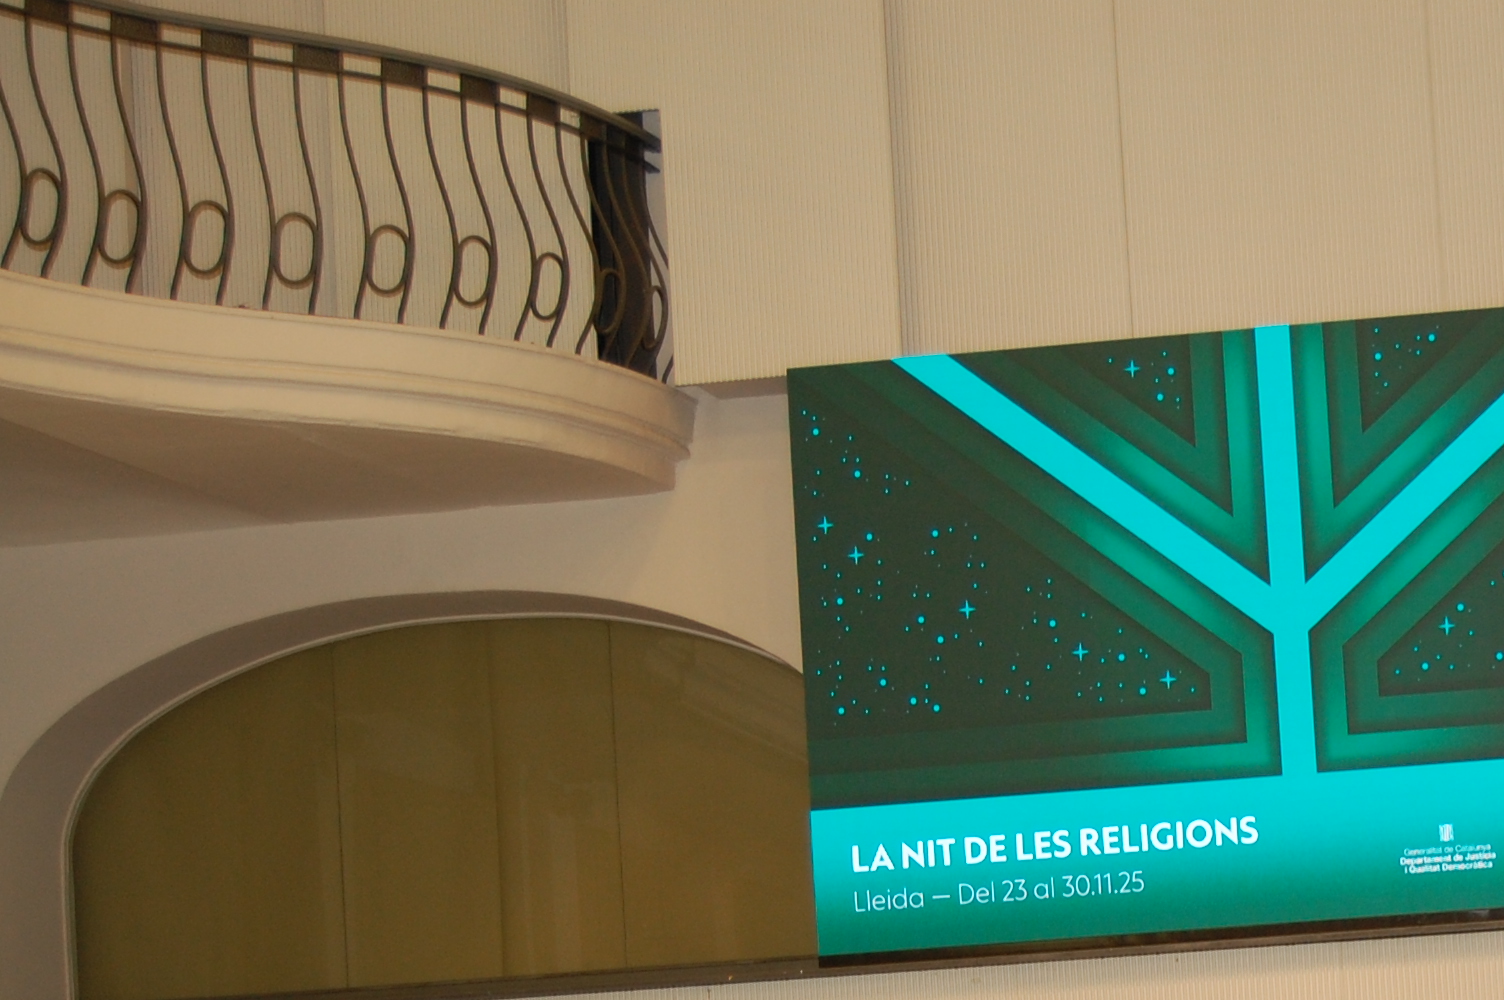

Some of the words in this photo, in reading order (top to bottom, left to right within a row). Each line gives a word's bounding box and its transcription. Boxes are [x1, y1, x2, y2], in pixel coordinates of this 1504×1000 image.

[851, 843, 895, 873] LA
[901, 838, 956, 869] NIT
[964, 834, 1006, 865] DE
[1015, 829, 1072, 862] LES
[1080, 815, 1260, 857] RELIGIONS
[854, 887, 925, 913] Lleida
[959, 880, 995, 906] Del
[1002, 878, 1027, 902] 23
[1033, 876, 1055, 900] al
[1062, 870, 1145, 898] 30.11.25
